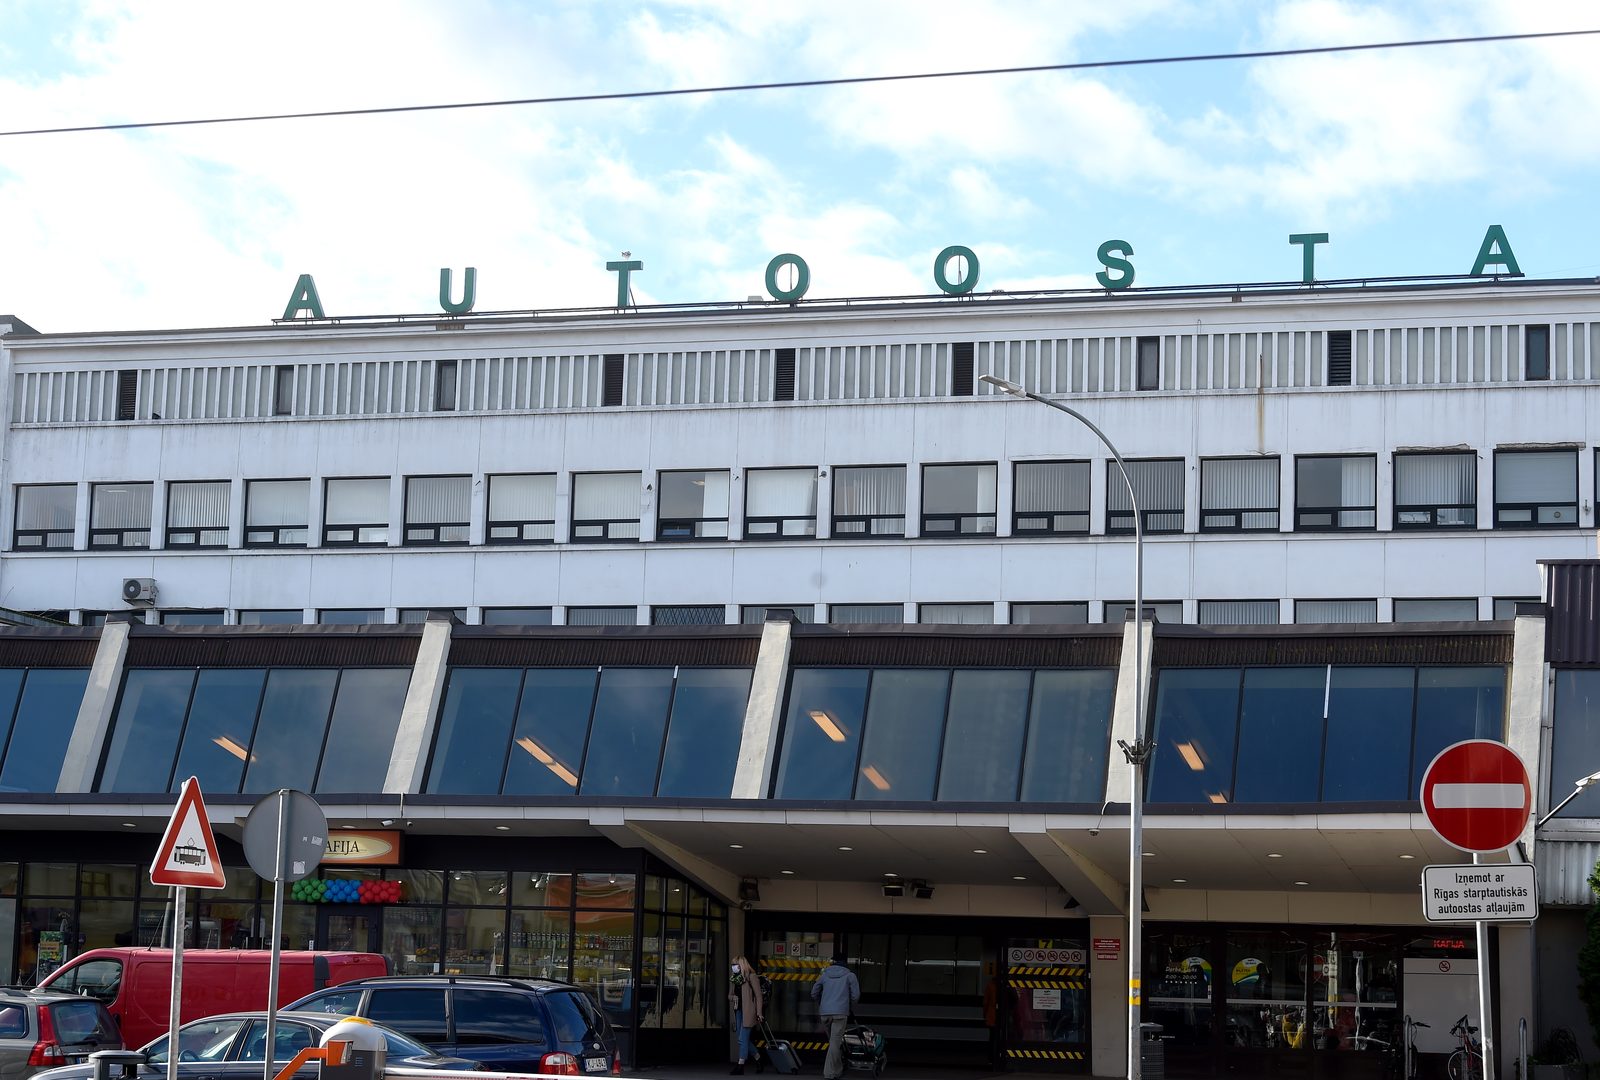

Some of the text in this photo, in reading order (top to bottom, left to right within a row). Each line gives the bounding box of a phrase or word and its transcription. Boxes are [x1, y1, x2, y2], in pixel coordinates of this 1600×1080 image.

[283, 225, 1525, 321] AUTOOSTA
[1455, 872, 1504, 885] Izņemot ar
[1434, 886, 1528, 901] Rīgas starptautiskās
[1438, 902, 1525, 915] autoostas atļaujām
